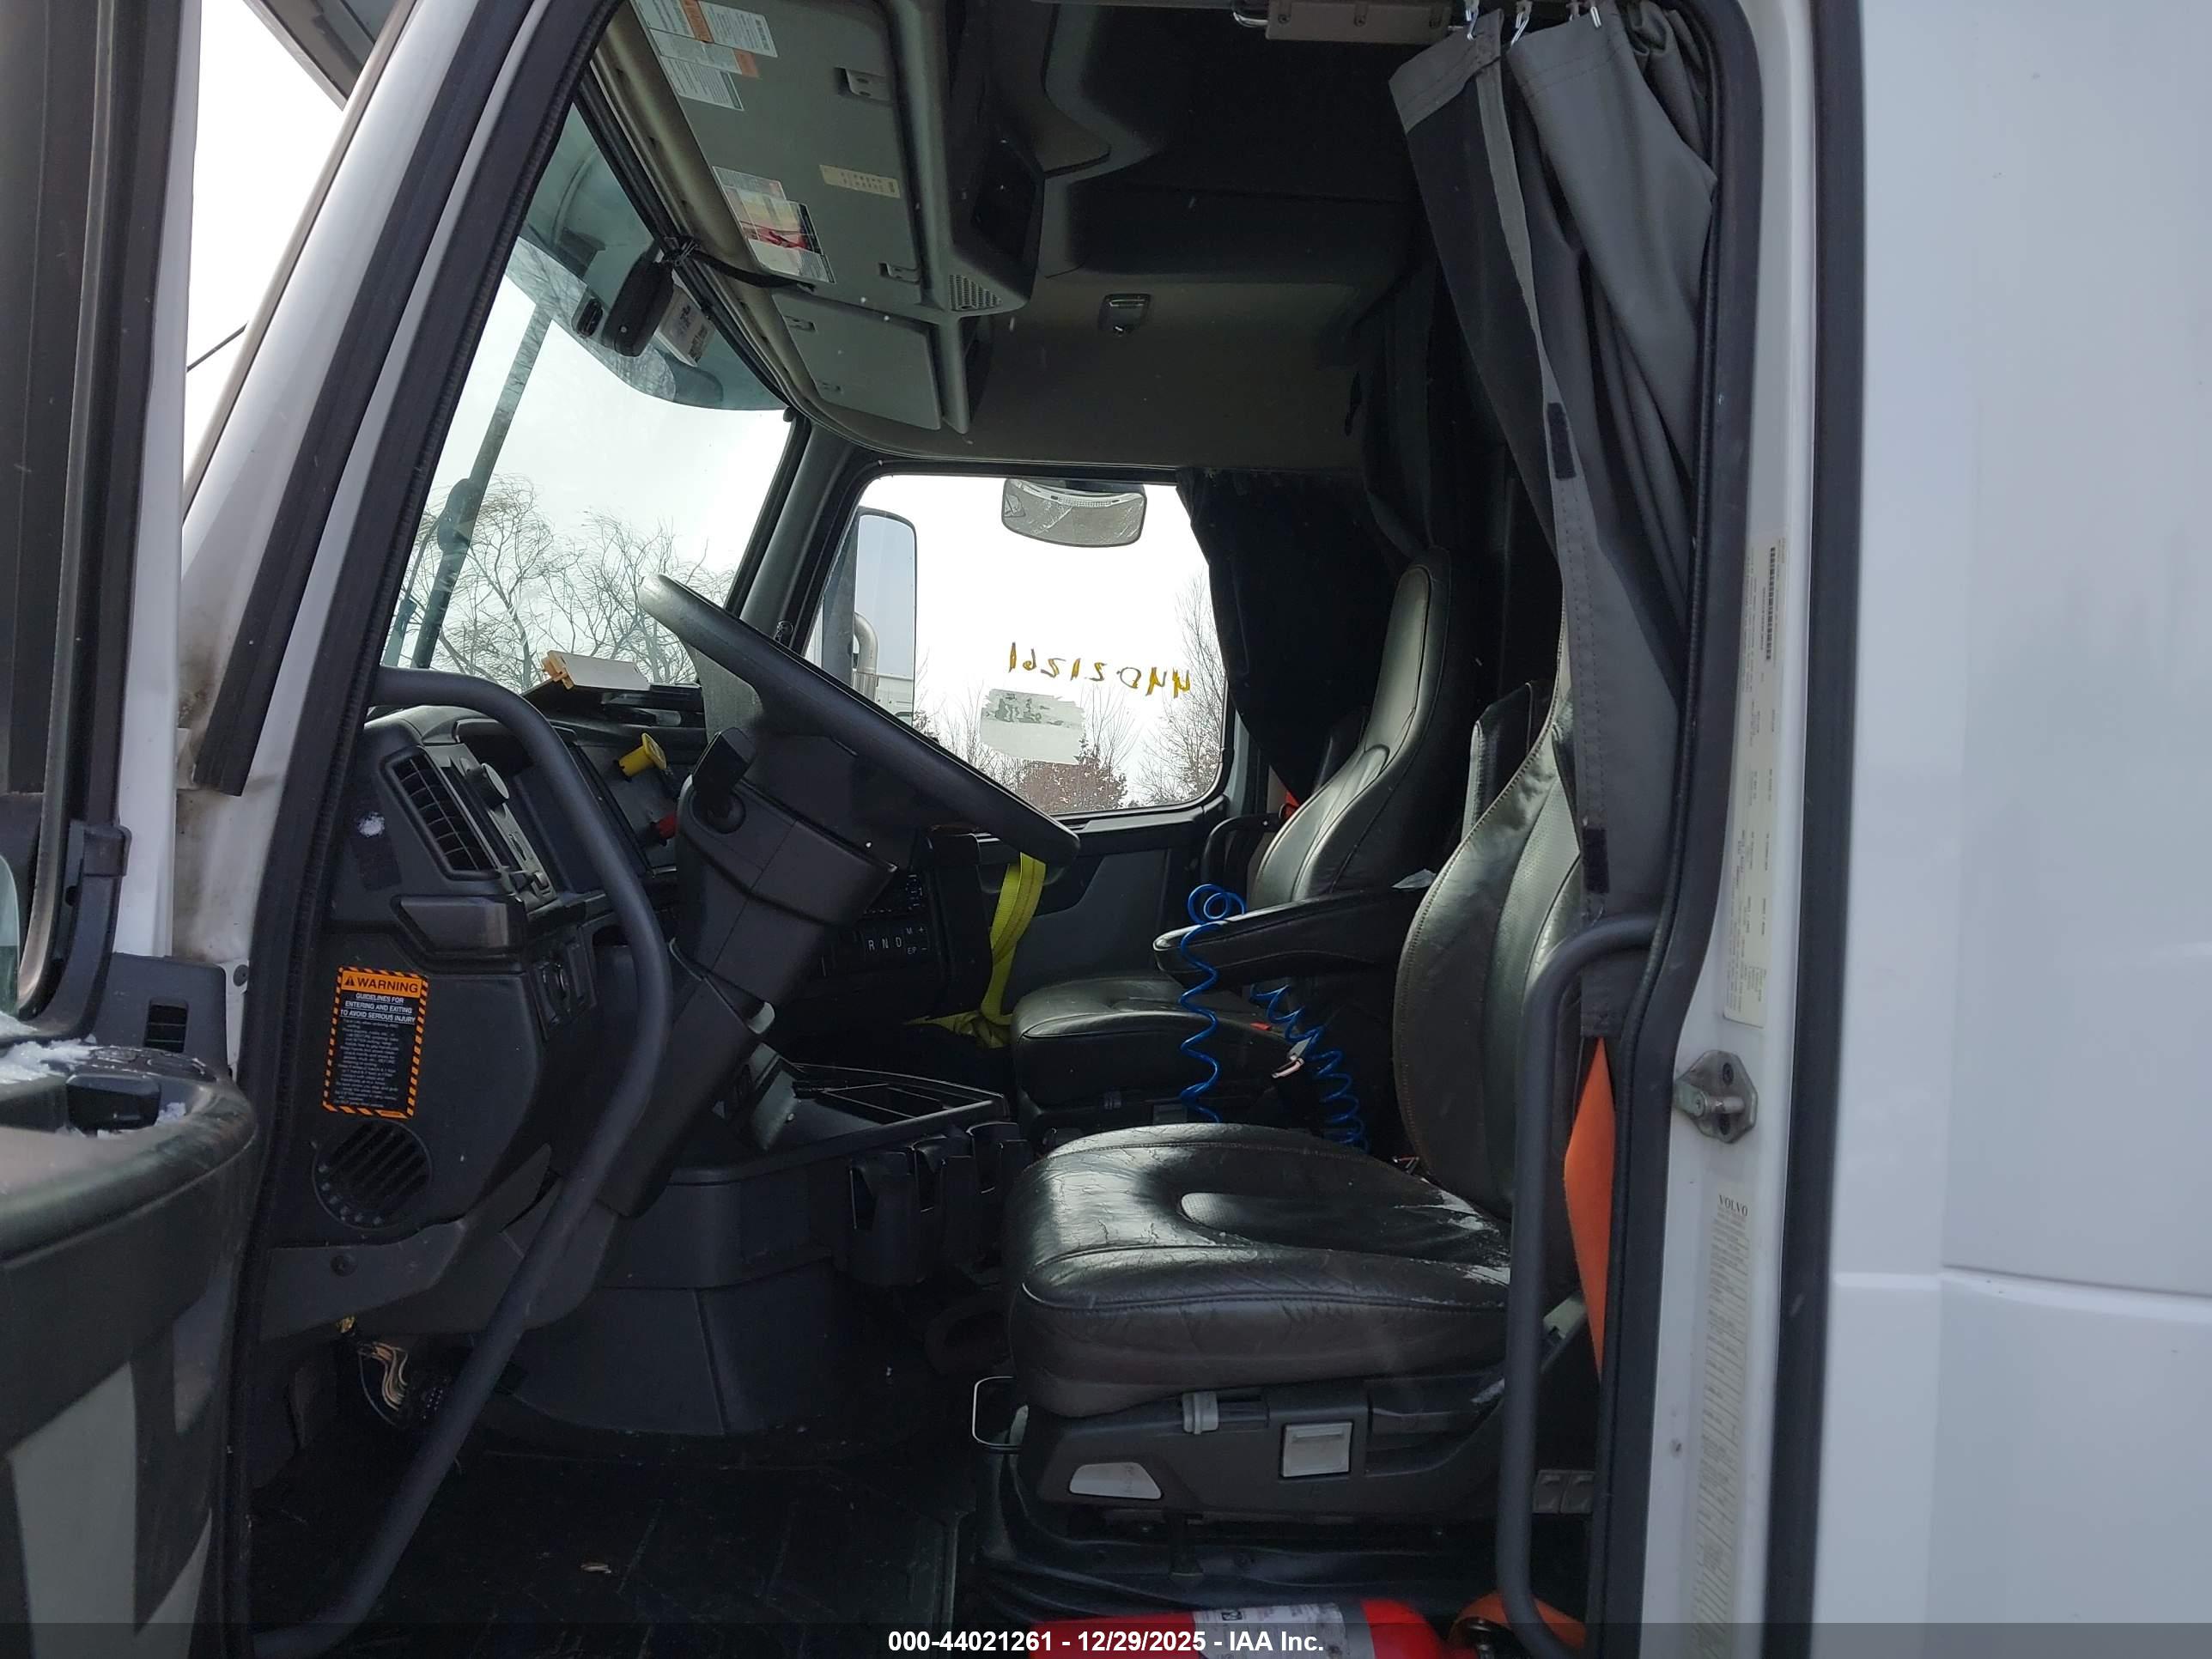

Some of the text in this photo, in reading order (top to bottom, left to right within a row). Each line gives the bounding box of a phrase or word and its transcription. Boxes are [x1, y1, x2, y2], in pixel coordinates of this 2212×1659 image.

[357, 976, 418, 994] WARNING
[356, 994, 390, 1003] GUIDELINES
[344, 1000, 375, 1010] ENTERING
[389, 1006, 412, 1014] EXITING
[368, 1012, 394, 1021] SERIOUS
[394, 1015, 416, 1024] INJURY
[1718, 1194, 1748, 1217] VOLVO
